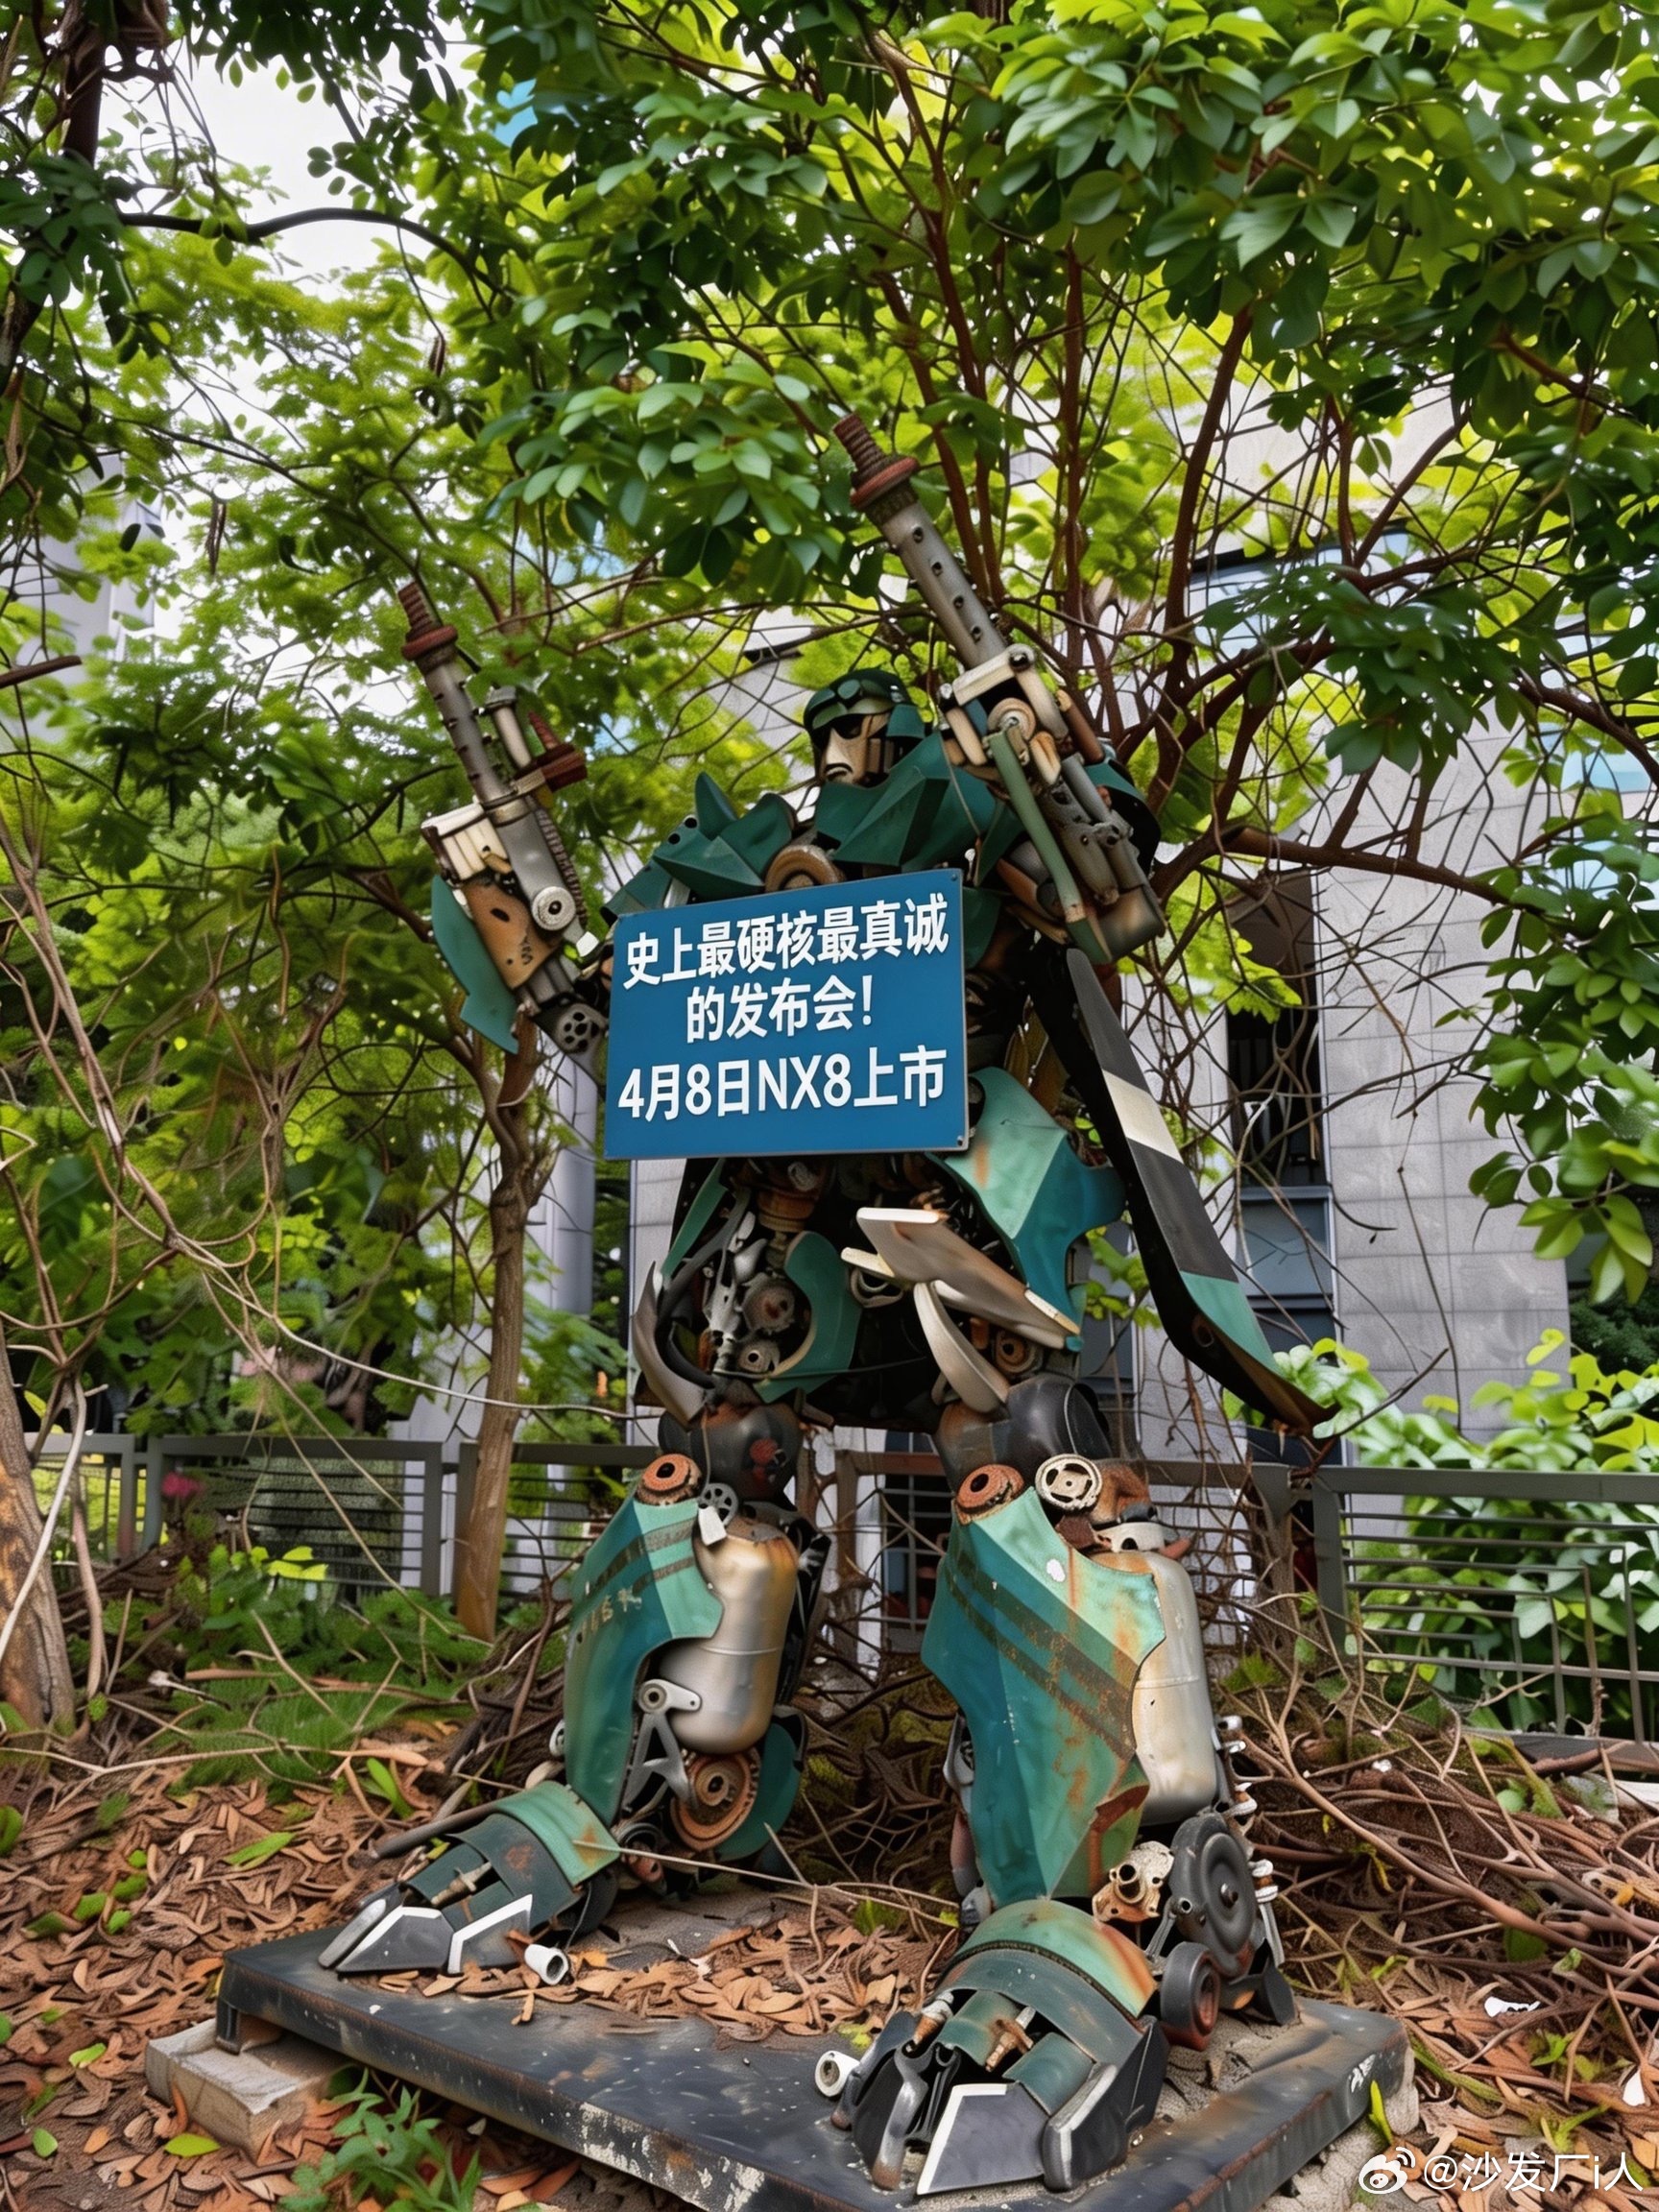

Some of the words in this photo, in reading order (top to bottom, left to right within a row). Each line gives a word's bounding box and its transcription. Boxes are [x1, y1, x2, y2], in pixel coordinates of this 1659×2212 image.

[622, 893, 950, 990] 史上最硬核最真诚
[686, 974, 873, 1044] 的发布会！
[617, 1045, 948, 1121] 4月8日NX8上市
